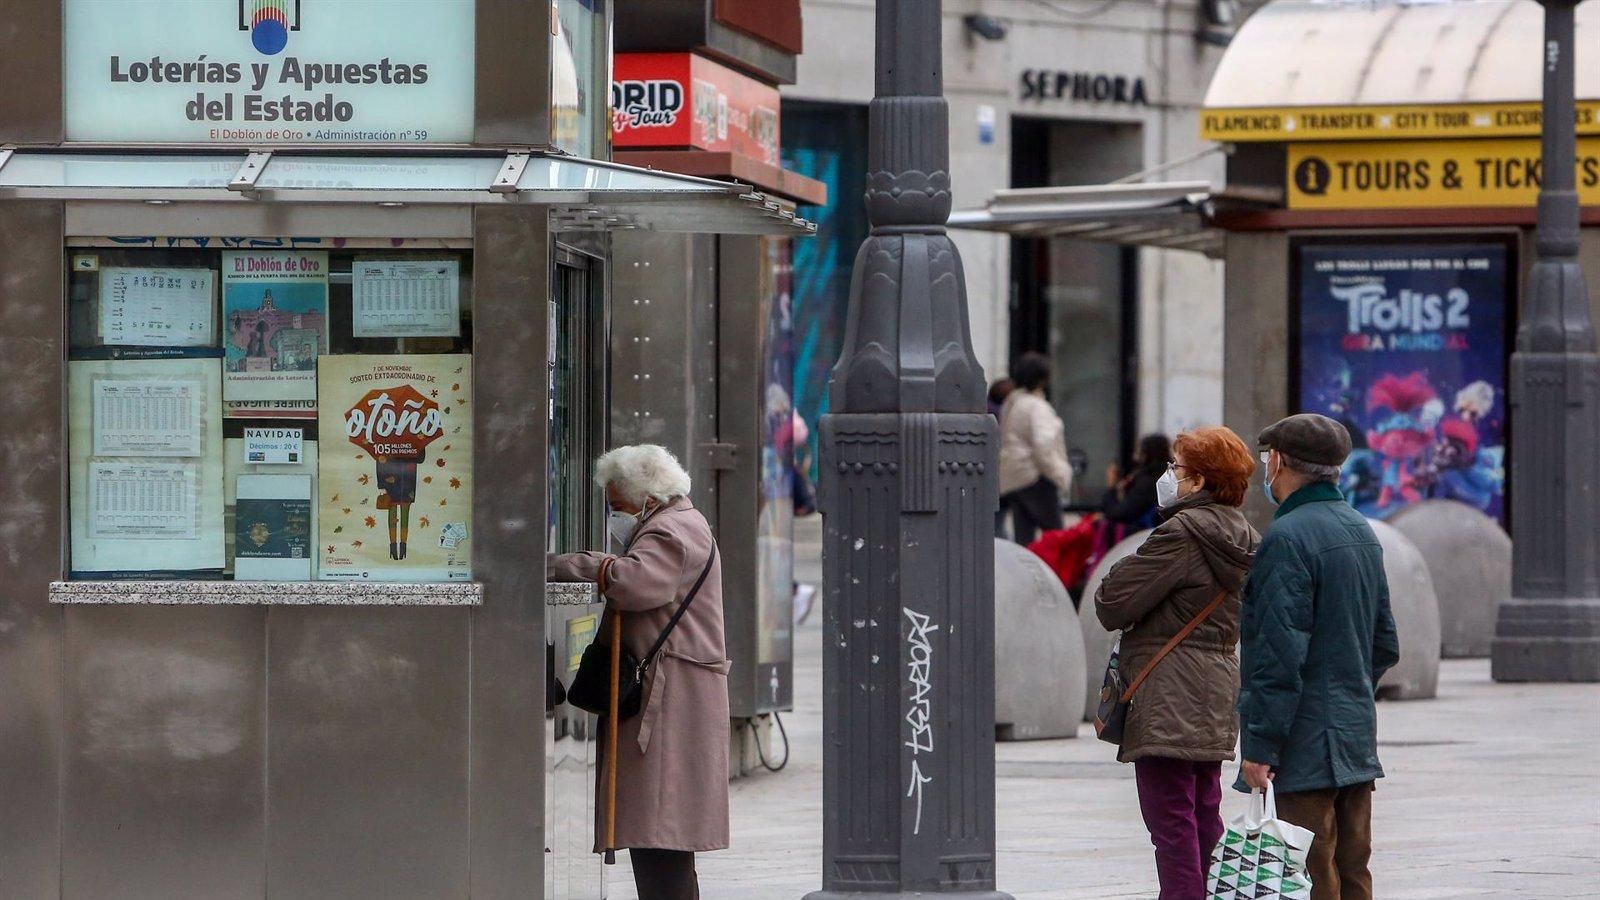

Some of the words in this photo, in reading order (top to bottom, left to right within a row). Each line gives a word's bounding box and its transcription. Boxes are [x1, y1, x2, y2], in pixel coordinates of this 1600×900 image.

[110, 55, 242, 84] Loterías
[252, 63, 270, 91] y
[280, 57, 429, 91] Apuestas
[1021, 69, 1148, 105] SEPHORA
[185, 93, 233, 122] del
[243, 94, 354, 122] Estado
[629, 106, 674, 126] Tour
[1205, 115, 1281, 132] FLAMENCO
[1301, 113, 1375, 130] TRANSFER
[1396, 113, 1428, 128] CITY
[1434, 112, 1470, 127] TOUR
[210, 130, 220, 140] El
[223, 129, 263, 140] Doblón
[265, 130, 279, 140] de
[282, 130, 304, 140] Oro
[315, 130, 396, 140] Administración
[415, 131, 428, 141] 59
[1337, 159, 1430, 191] TOURS
[1442, 159, 1462, 190] &
[234, 257, 245, 272] El
[247, 257, 282, 272] Doblón
[285, 257, 297, 272] de
[300, 257, 320, 272] Oro
[1330, 283, 1444, 333] Trolls
[1447, 288, 1470, 328] 2
[349, 372, 373, 384] SORTEO
[374, 372, 426, 381] EXTRAORDINARIO
[426, 375, 436, 383] DE
[344, 392, 442, 444] otoño
[246, 430, 301, 439] NAVIDAD
[373, 443, 391, 455] 105
